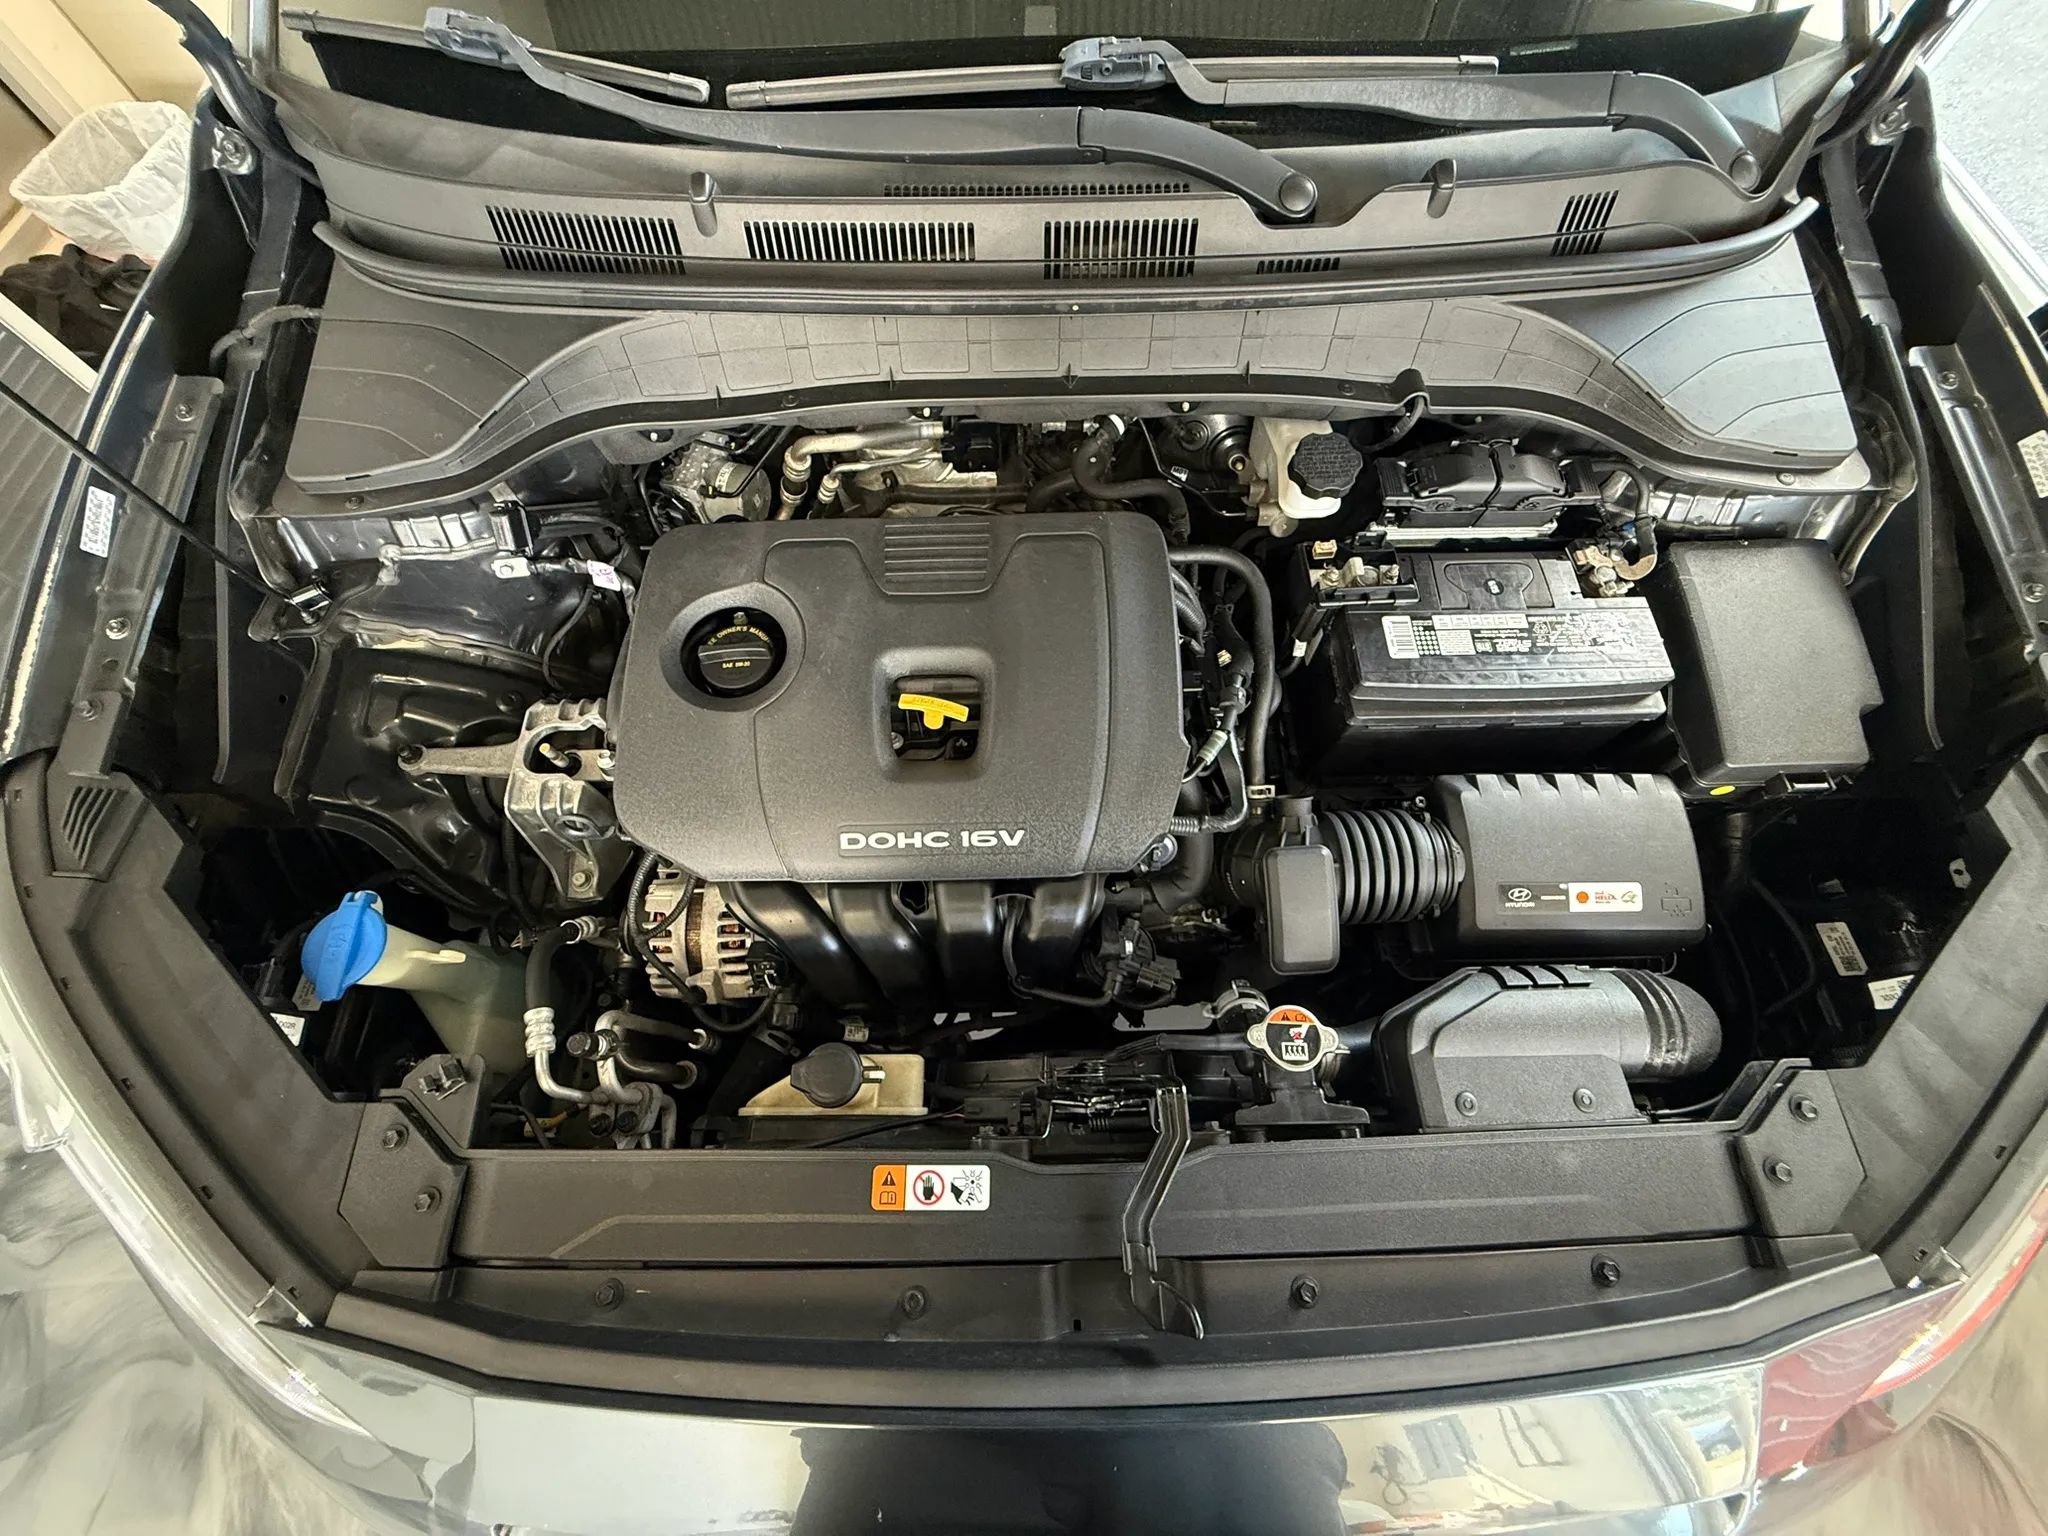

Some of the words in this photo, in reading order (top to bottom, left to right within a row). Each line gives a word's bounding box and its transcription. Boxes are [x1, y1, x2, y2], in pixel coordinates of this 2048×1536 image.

[716, 625, 748, 639] OWNER'S
[839, 831, 951, 850] DOHC
[960, 829, 1026, 848] 16V
